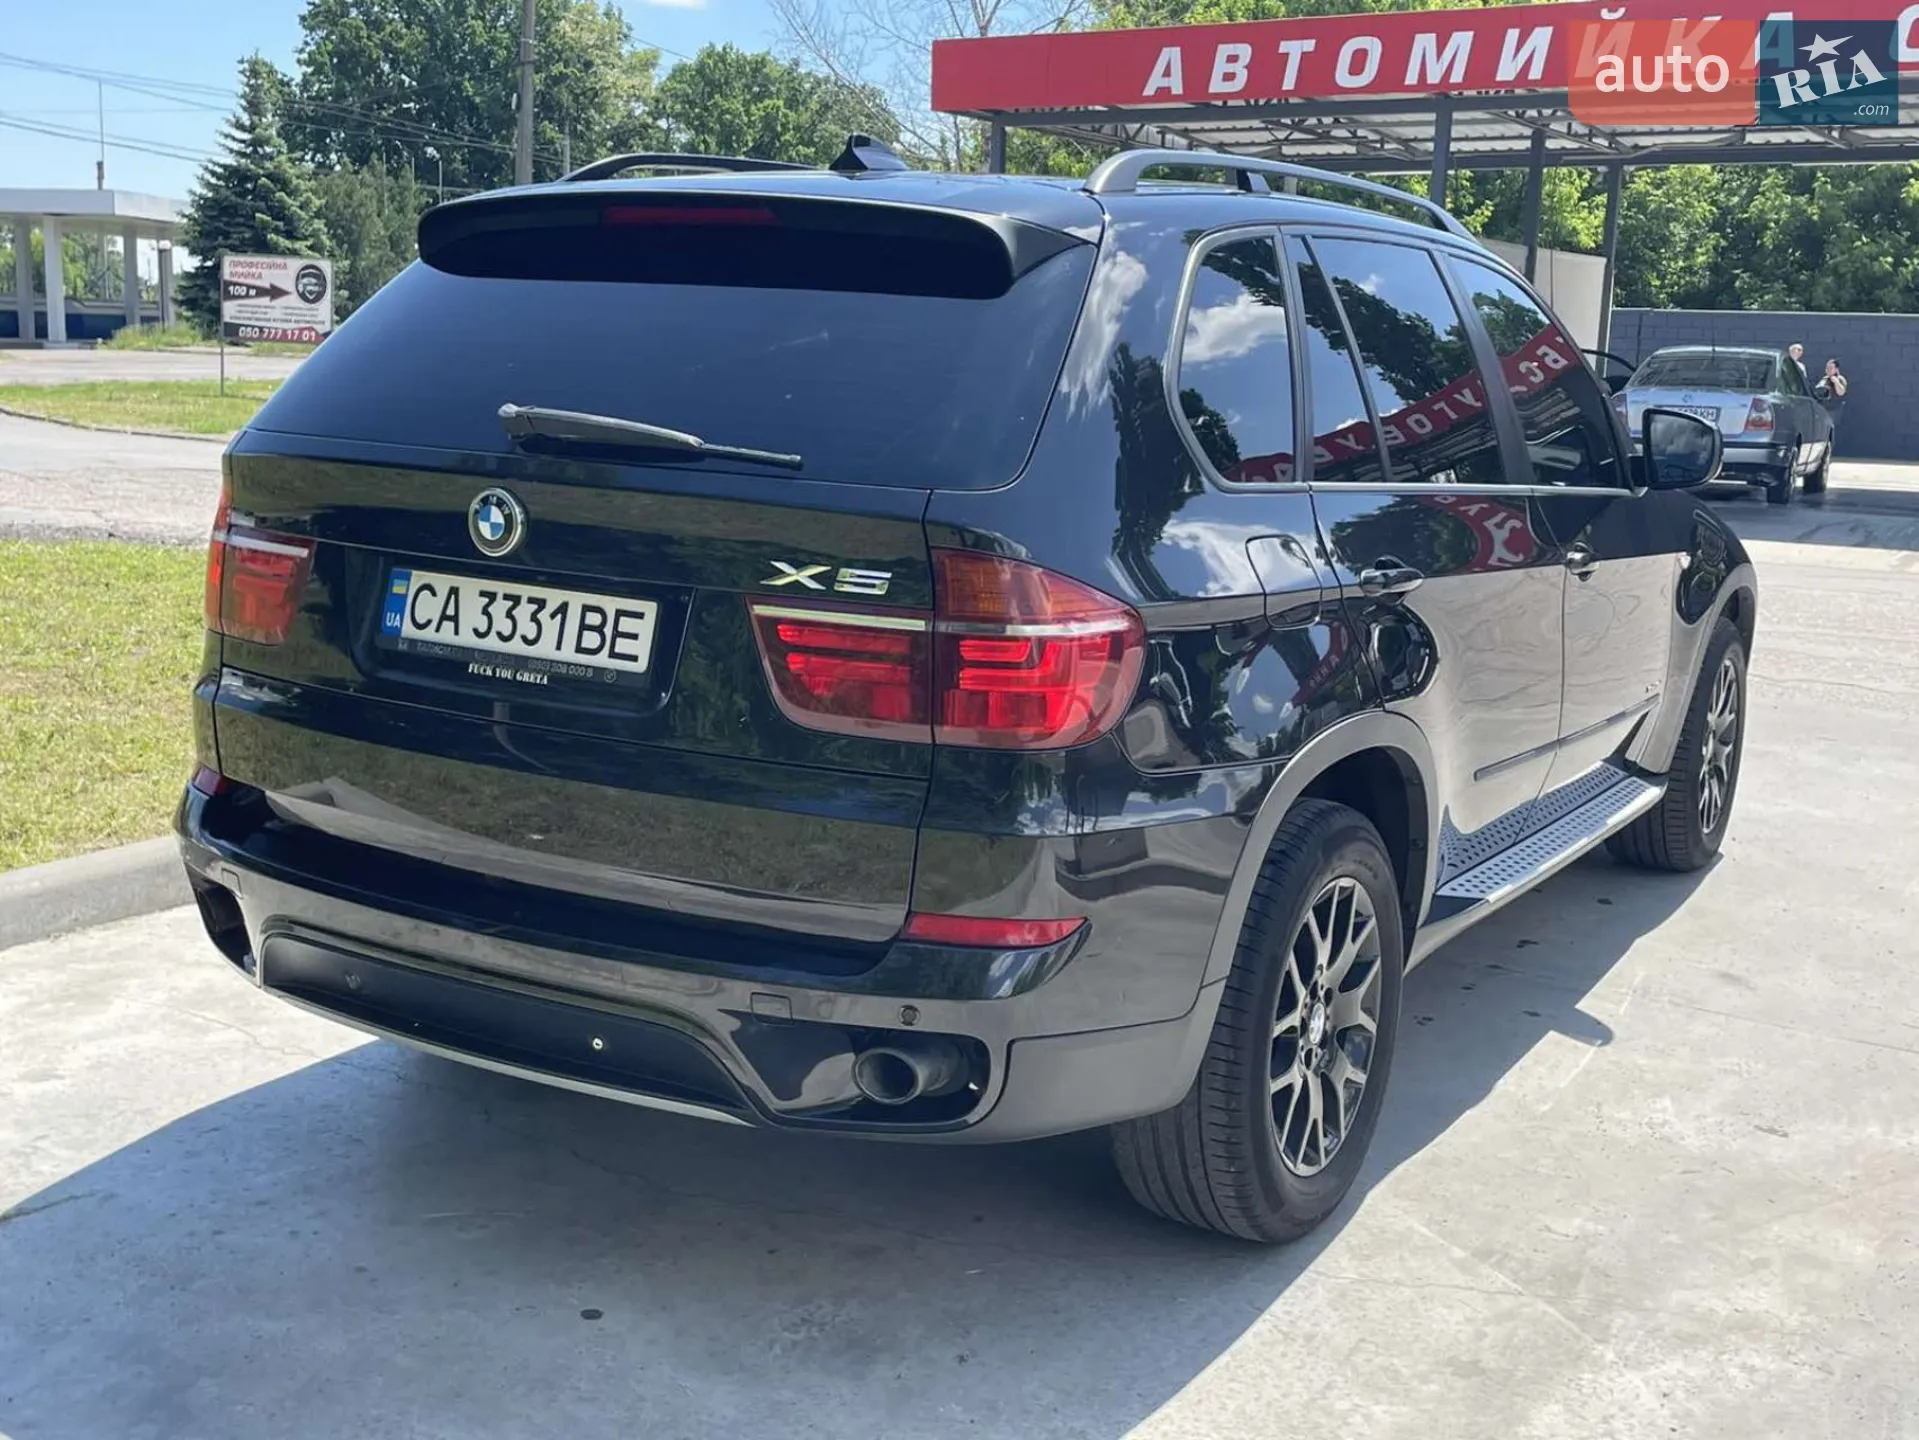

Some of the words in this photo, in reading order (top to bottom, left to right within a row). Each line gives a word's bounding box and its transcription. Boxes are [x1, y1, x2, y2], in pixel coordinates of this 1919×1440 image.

[228, 286, 247, 297] 100
[238, 326, 260, 338] 050
[262, 328, 282, 340] 777
[286, 330, 299, 341] 17
[302, 331, 316, 342] 01
[759, 560, 893, 595] X5
[386, 612, 401, 628] UA
[468, 662, 492, 677] FUCK
[495, 667, 515, 680] YOU
[515, 670, 548, 685] GRETA
